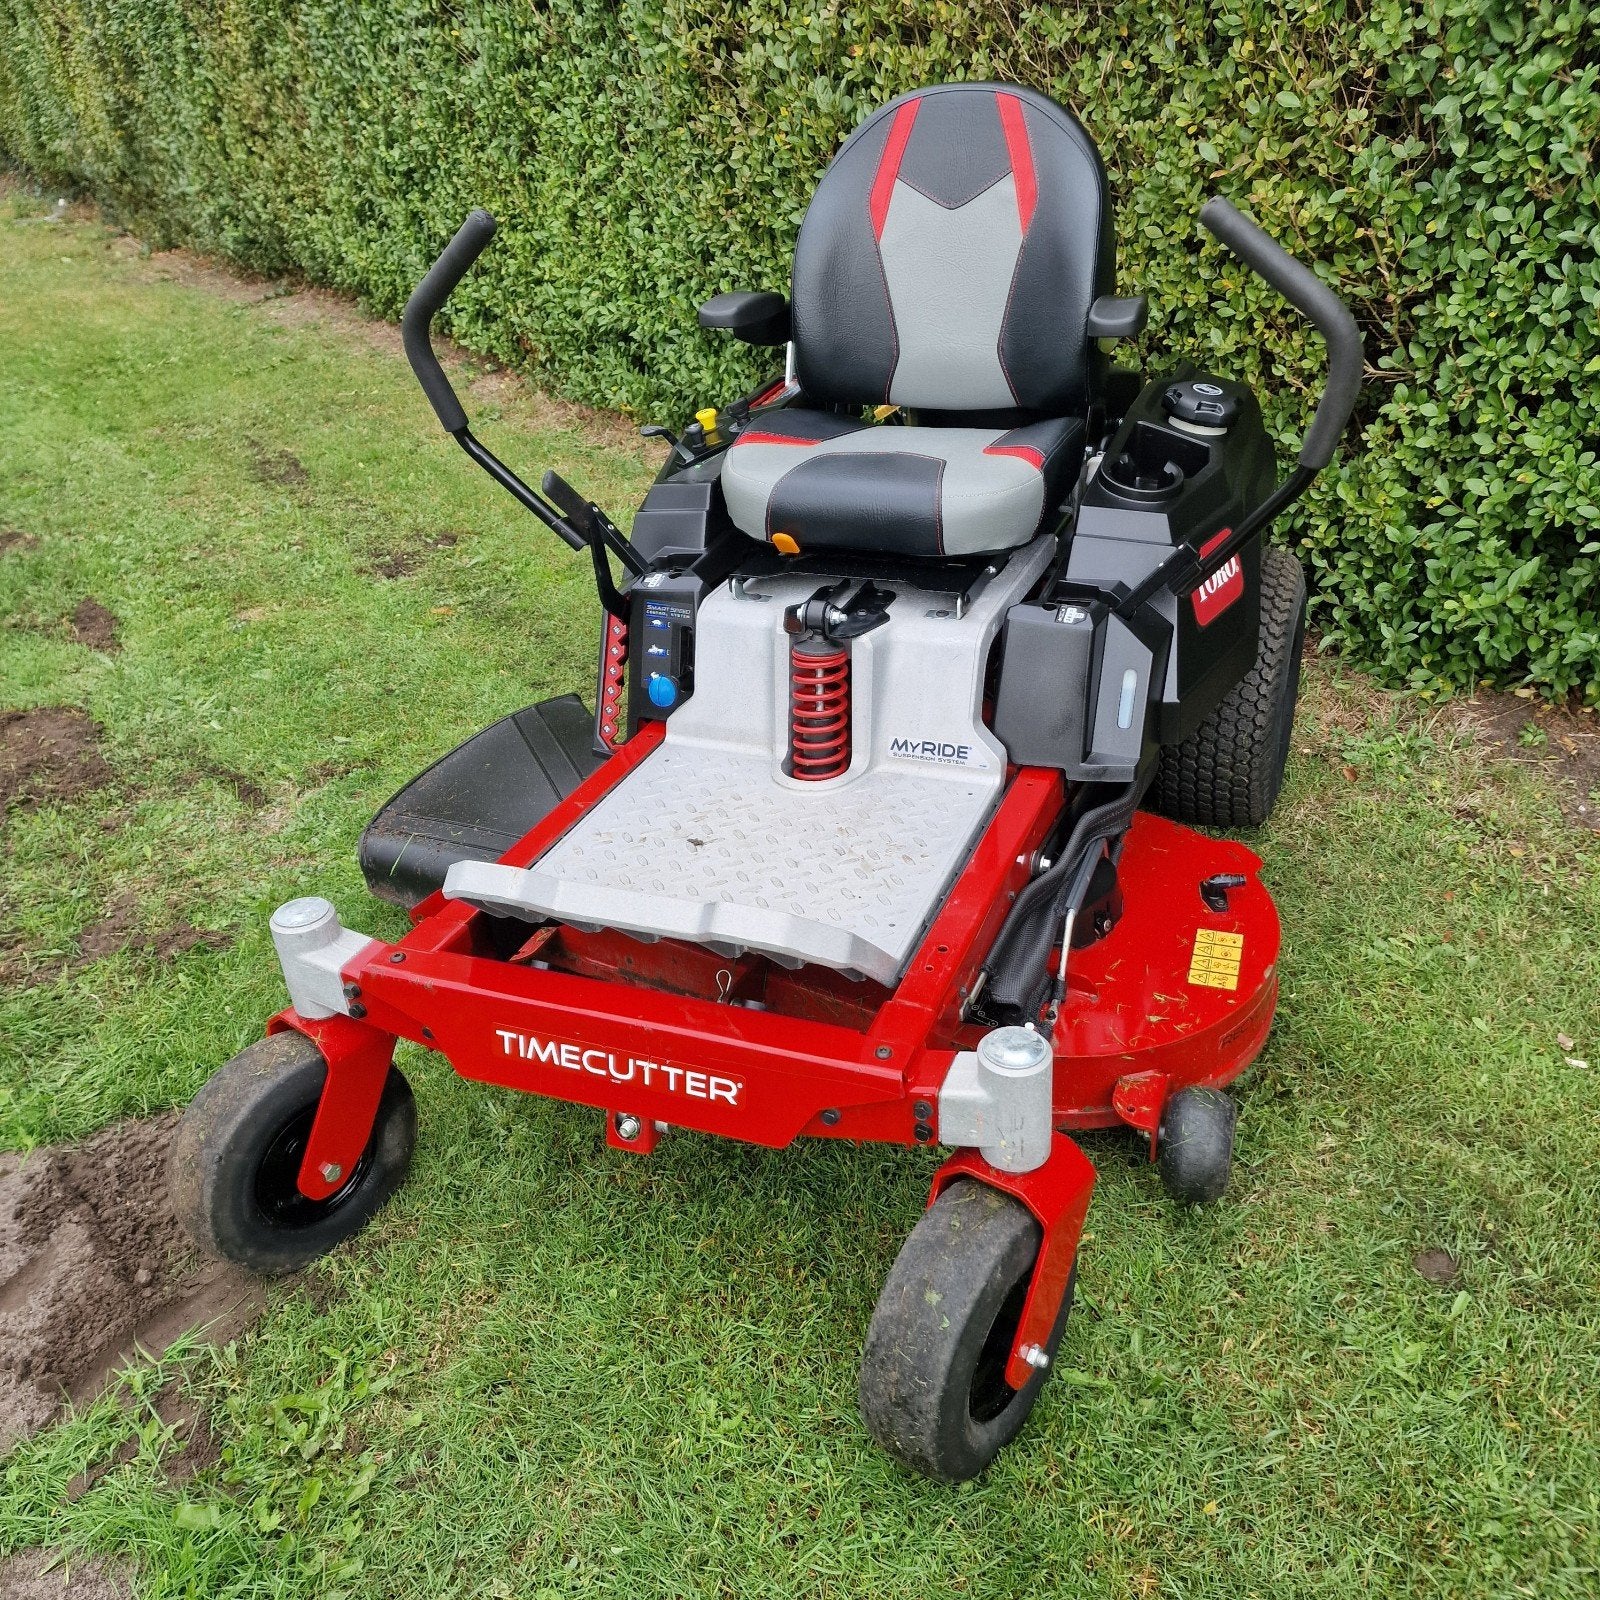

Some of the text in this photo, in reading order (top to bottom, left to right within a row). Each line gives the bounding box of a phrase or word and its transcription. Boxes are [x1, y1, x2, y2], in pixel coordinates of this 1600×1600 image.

[892, 752, 966, 766] SUSPENSION SYSTEM
[495, 1029, 738, 1106] TIMECUTTER
